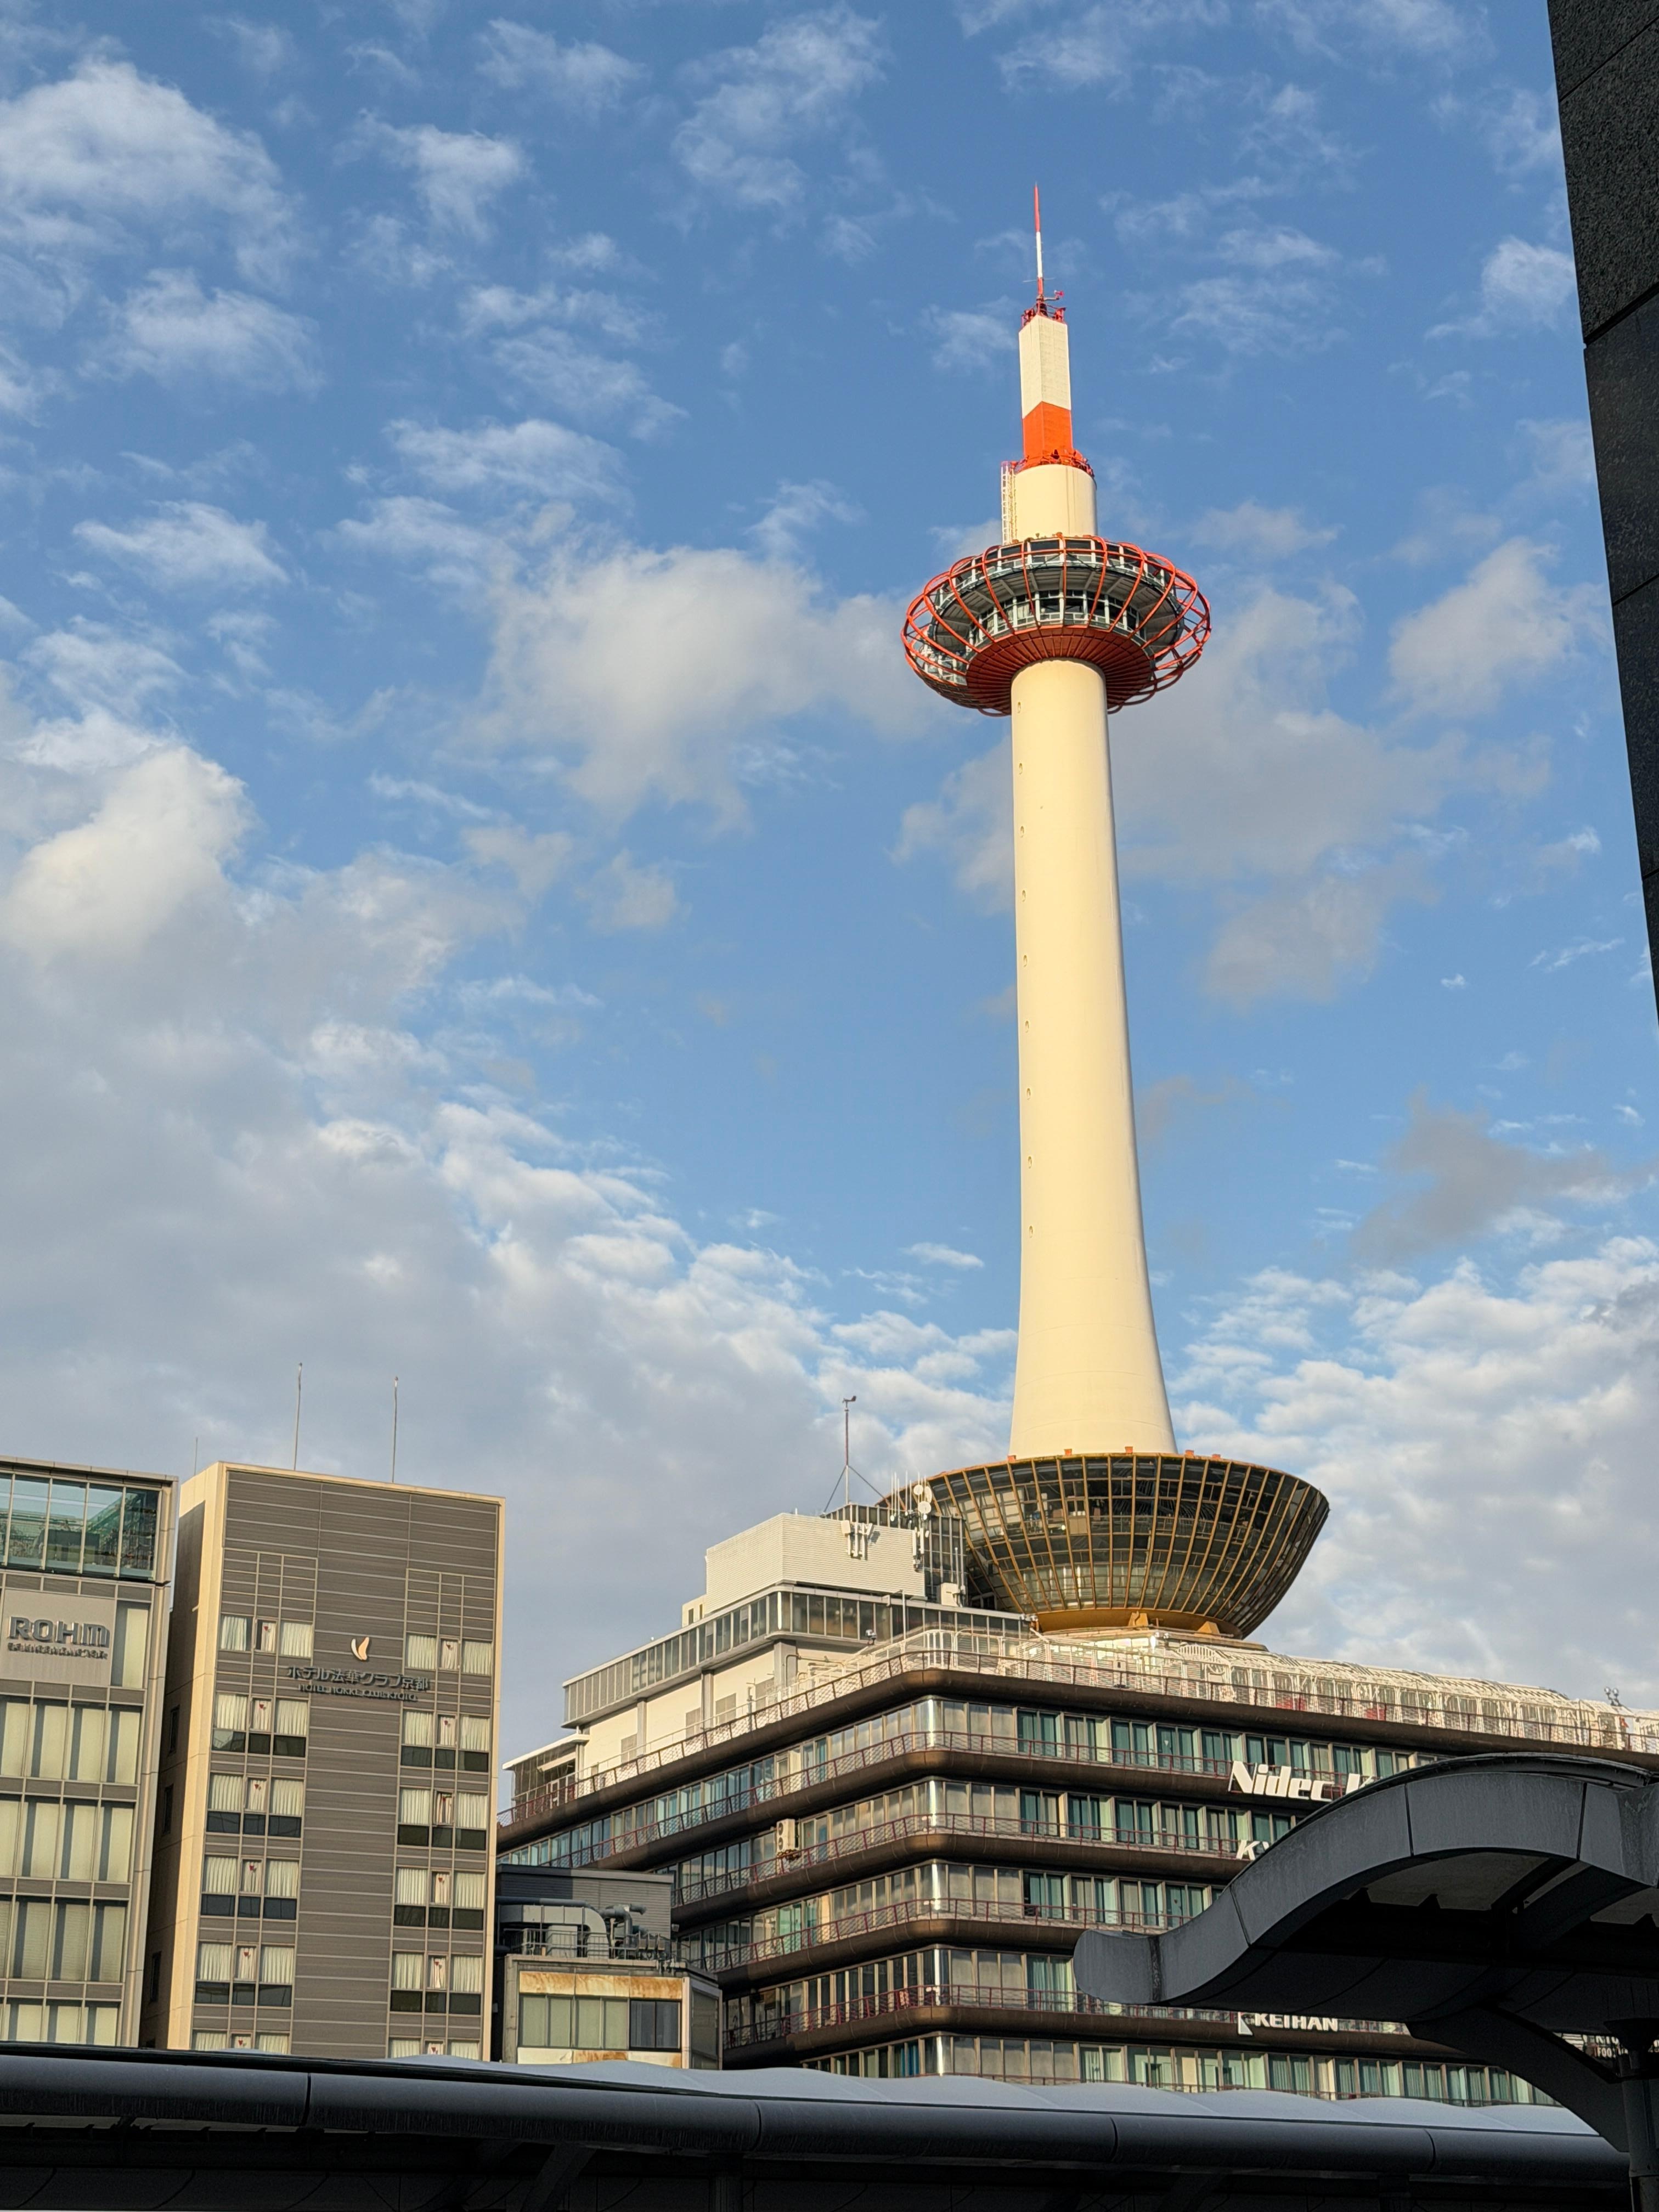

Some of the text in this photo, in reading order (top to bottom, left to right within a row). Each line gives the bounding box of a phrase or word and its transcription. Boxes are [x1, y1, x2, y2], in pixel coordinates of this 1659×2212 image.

[8, 1616, 110, 1648] ROHM
[287, 1666, 429, 1691] ホテル法華クラブ京都
[1228, 1760, 1335, 1802] Nidec
[1255, 2013, 1338, 2032] KEIHAN
